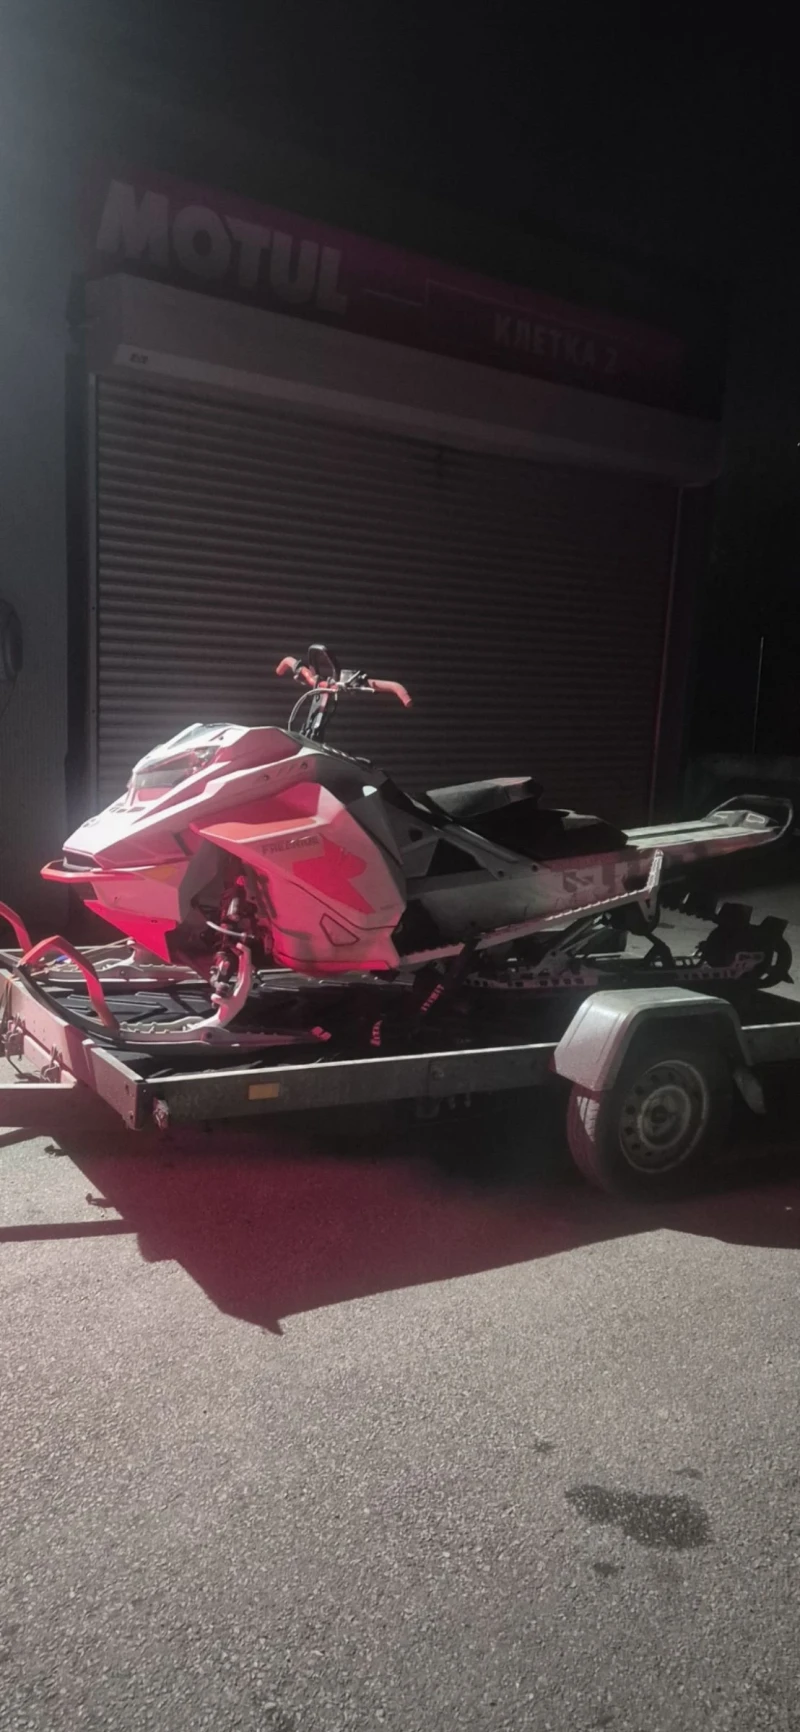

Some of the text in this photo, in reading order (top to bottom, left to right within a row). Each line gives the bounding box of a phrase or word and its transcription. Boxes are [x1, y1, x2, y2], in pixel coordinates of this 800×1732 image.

[96, 179, 347, 316] MOTUL
[494, 312, 618, 373] КЛЕТКА 2
